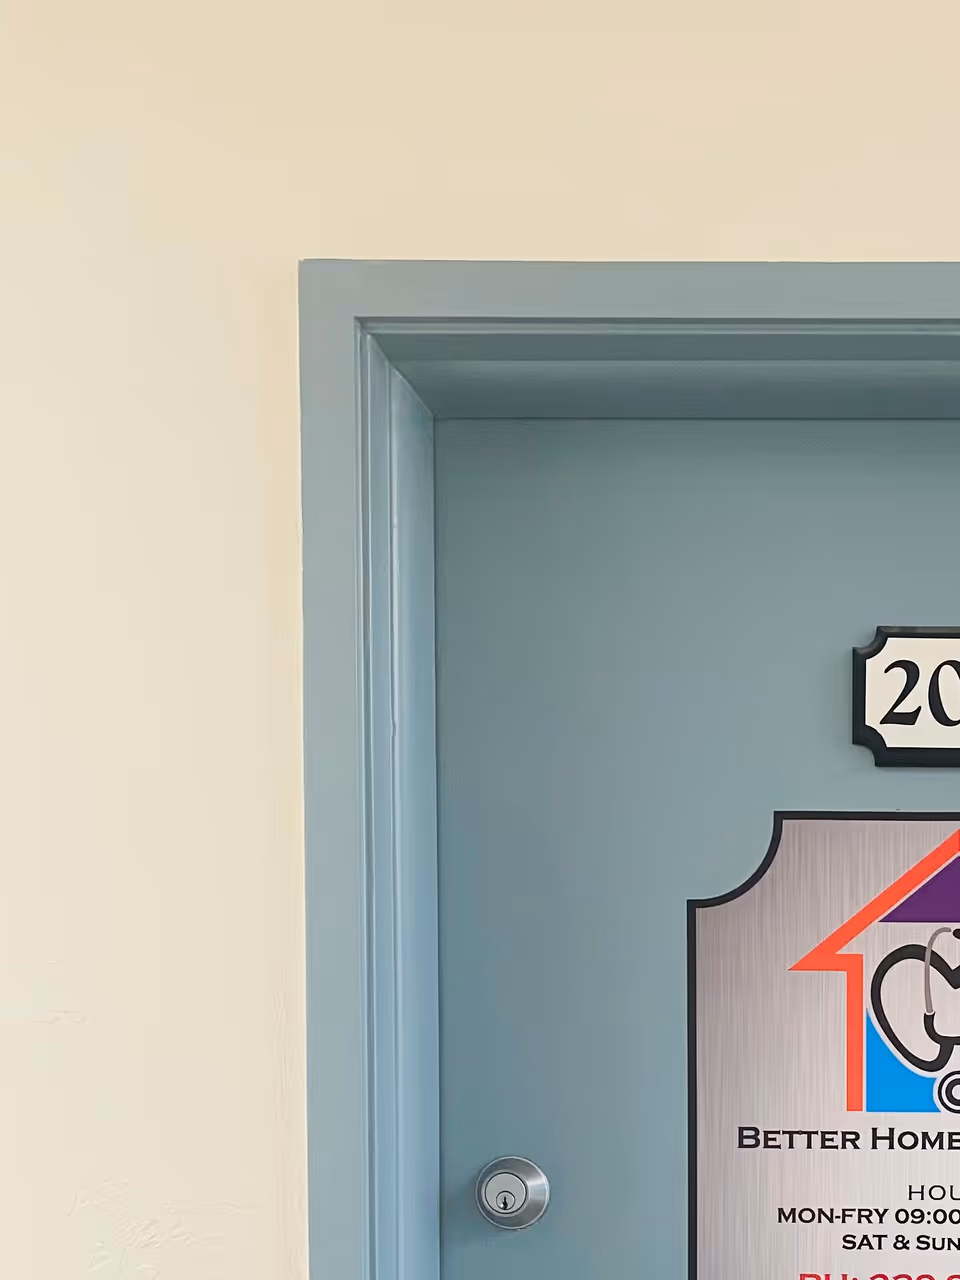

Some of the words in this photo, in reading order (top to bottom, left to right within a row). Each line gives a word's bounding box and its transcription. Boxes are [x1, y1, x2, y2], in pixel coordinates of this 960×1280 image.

[737, 1126, 861, 1151] BETTER
[777, 1207, 890, 1225] MON-FRY
[841, 1233, 889, 1251] SAT
[892, 1234, 910, 1251] &
